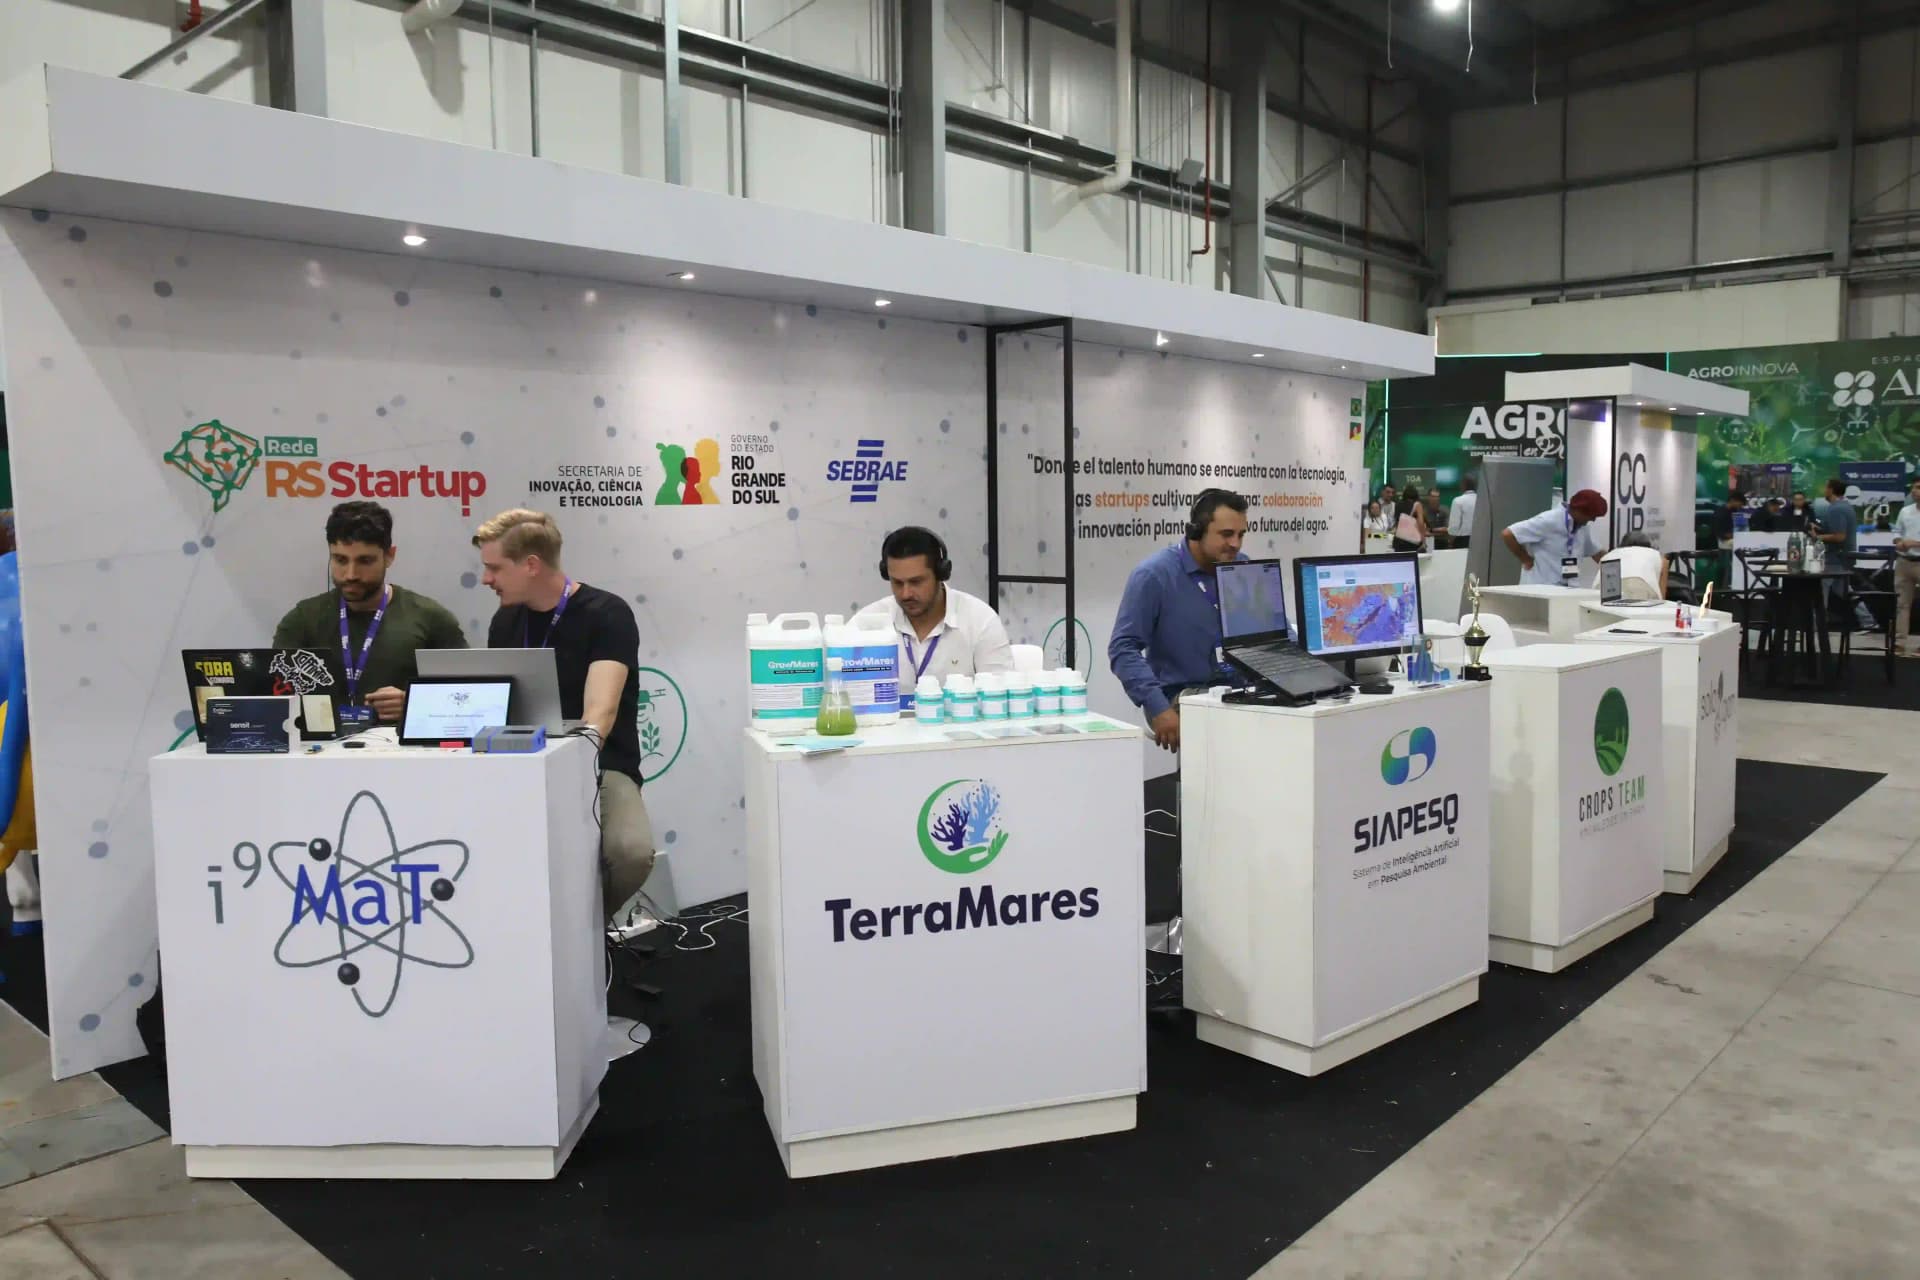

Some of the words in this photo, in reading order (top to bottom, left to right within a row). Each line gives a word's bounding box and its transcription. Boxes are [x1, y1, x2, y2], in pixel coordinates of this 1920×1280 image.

[1687, 362, 1799, 379] AGROINNOVA
[268, 440, 314, 455] Rede
[731, 435, 768, 444] GOVERNO
[731, 444, 742, 453] DO
[745, 444, 774, 453] ESTADO
[558, 465, 627, 478] SECRETARIA
[632, 465, 643, 478] DE
[732, 456, 754, 470] RIO
[826, 460, 908, 482] SEBRAE
[1084, 457, 1096, 475] el
[1098, 457, 1145, 476] talento
[1148, 458, 1197, 477] humano
[1199, 464, 1212, 477] se
[1214, 464, 1267, 479] encuentra
[1269, 467, 1287, 480] con
[1288, 465, 1297, 480] la
[265, 460, 325, 498] RS
[328, 460, 487, 516] Startup
[529, 477, 595, 494] INOVAÇÃO,
[598, 477, 643, 493] CIÊNCIA
[731, 473, 786, 488] GRANDE
[560, 496, 567, 507] E
[570, 495, 643, 507] TECNOLOGIA
[732, 489, 752, 505] DO
[755, 489, 780, 505] SUL
[1075, 493, 1092, 508] as
[1095, 491, 1150, 512] startups
[1244, 495, 1261, 507] na:
[1078, 519, 1151, 539] innovación
[1260, 516, 1289, 532] futuro
[1290, 516, 1304, 532] del
[1579, 786, 1613, 822] CROPS
[1618, 775, 1645, 807] TEAM
[1353, 793, 1459, 854] SIAPESQ
[1392, 846, 1432, 868] Inteligência
[1381, 868, 1412, 886] Pesquisa
[291, 863, 439, 926] MaT
[824, 884, 1100, 943] TerraMares
